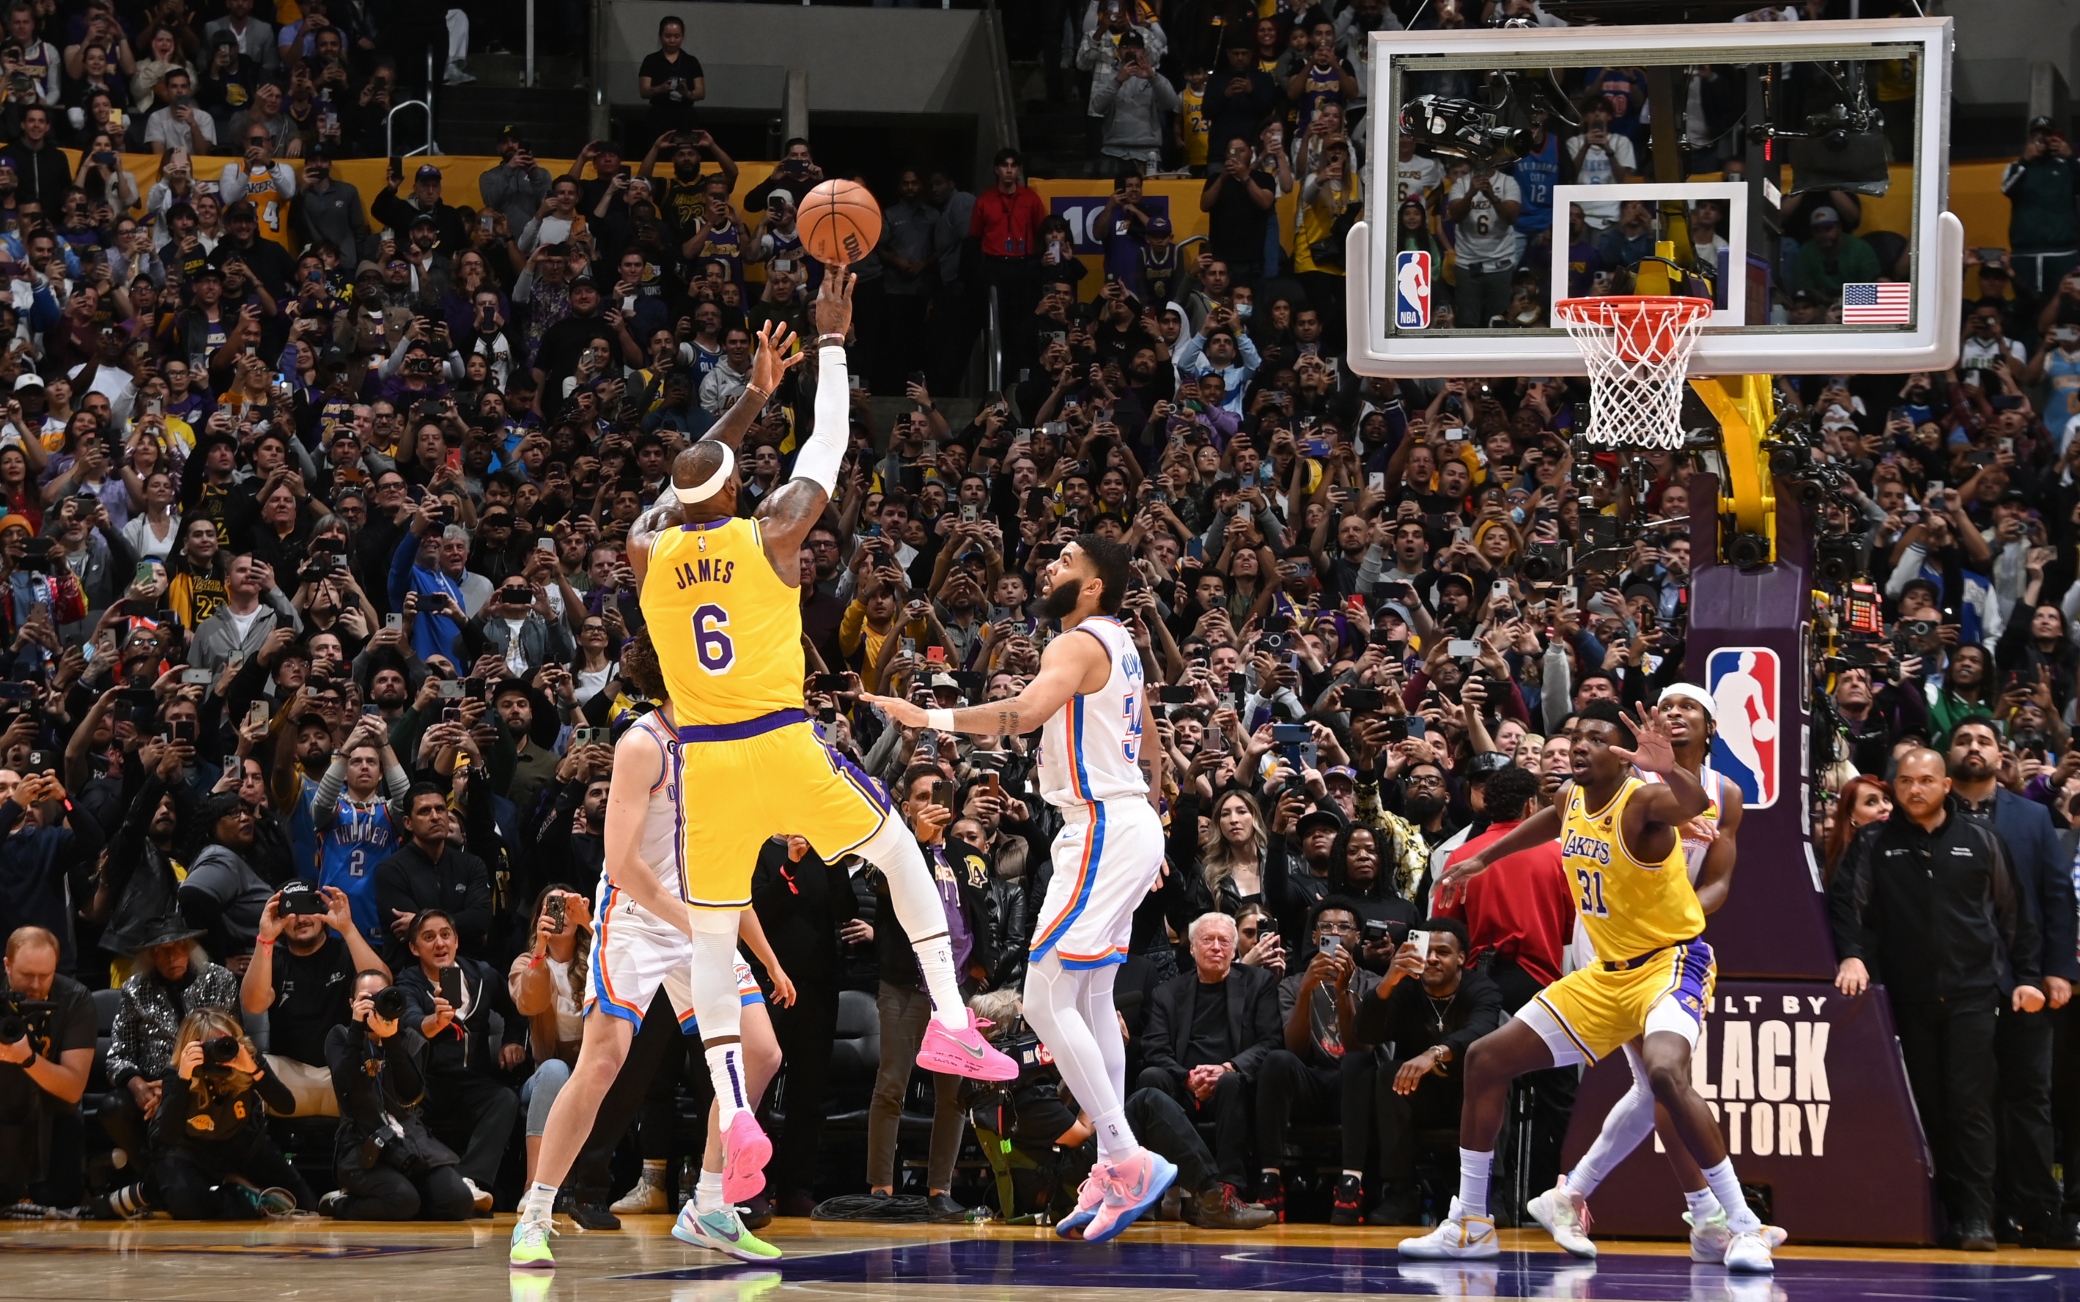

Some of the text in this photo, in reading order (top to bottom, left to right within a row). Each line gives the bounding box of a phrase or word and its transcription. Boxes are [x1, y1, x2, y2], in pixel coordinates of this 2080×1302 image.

[1530, 184, 1546, 203] 12
[1477, 215, 1488, 235] 6
[642, 285, 662, 296] IONS
[1400, 311, 1417, 324] NBA
[674, 558, 735, 590] JAMES
[691, 602, 737, 677] 6
[334, 824, 389, 848] THUNDER
[1562, 829, 1611, 865] LAKERS
[350, 849, 365, 877] 2
[1577, 867, 1610, 917] 31
[1706, 996, 1827, 1014] ILT BY
[1023, 1049, 1053, 1066] NBA TN
[1698, 1020, 1831, 1102] LACK
[234, 1100, 246, 1119] 6
